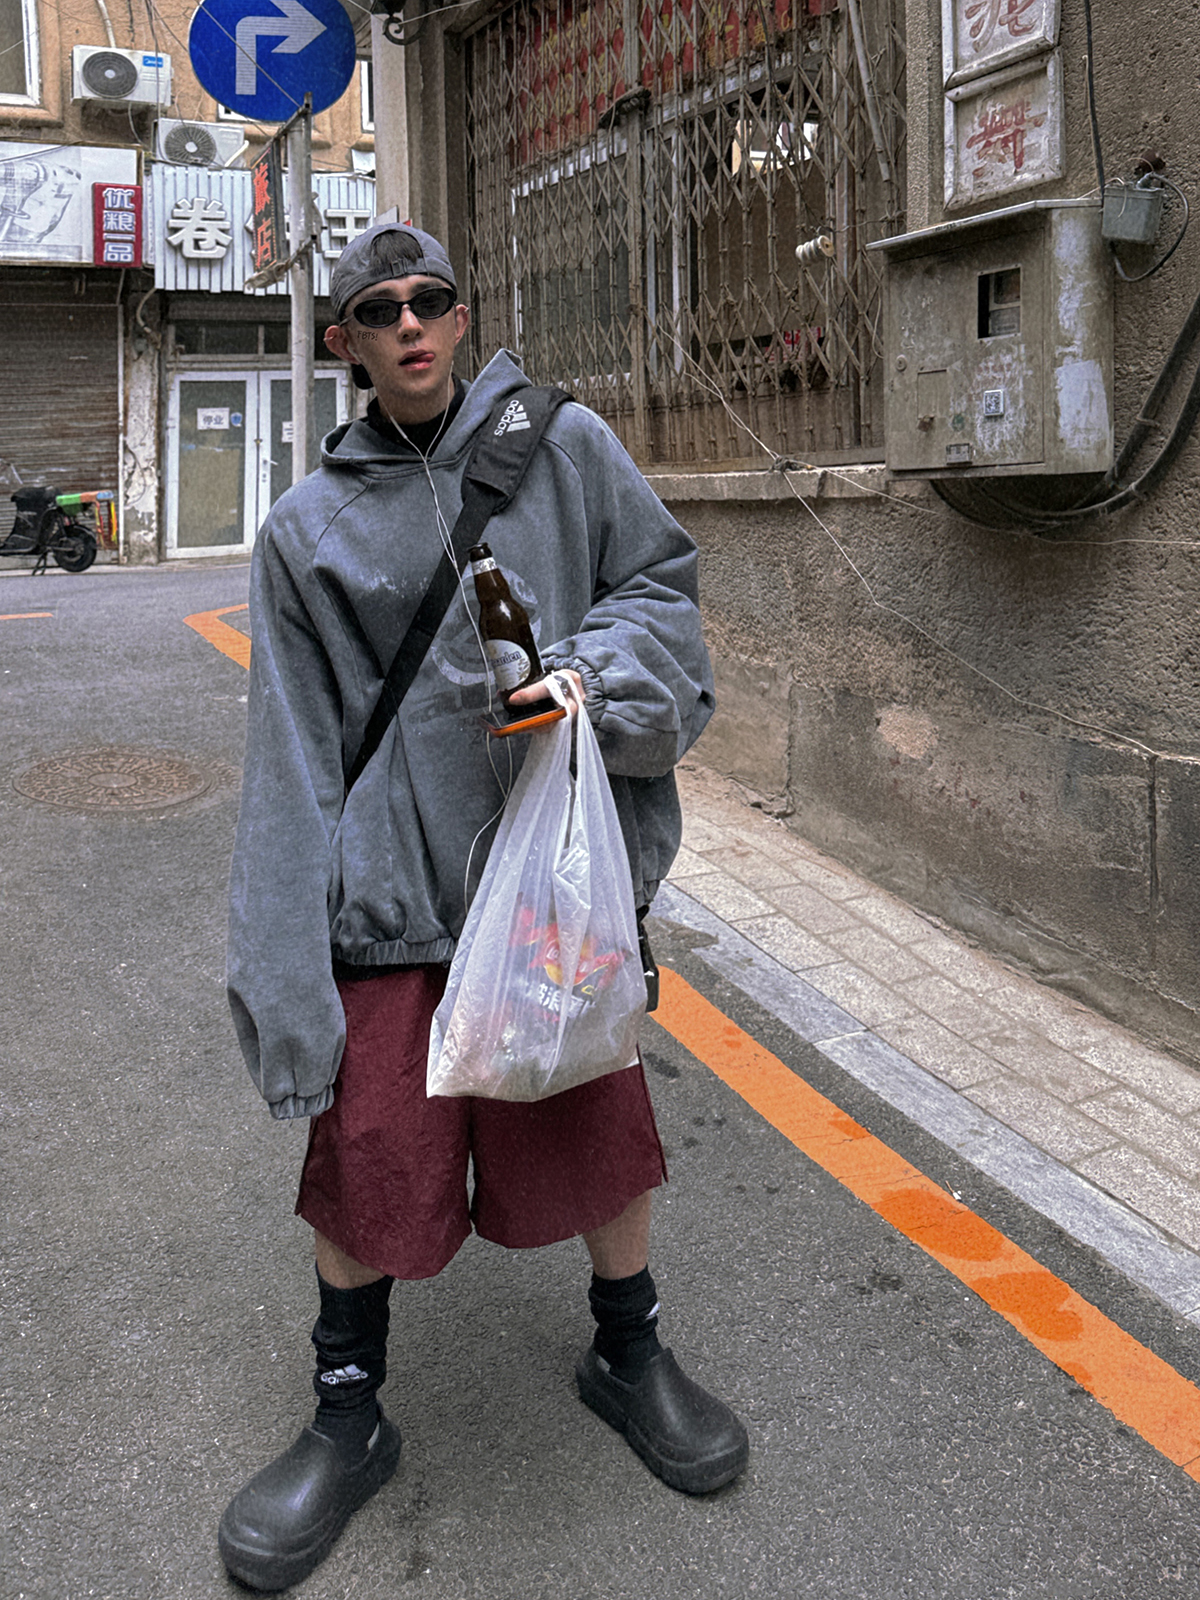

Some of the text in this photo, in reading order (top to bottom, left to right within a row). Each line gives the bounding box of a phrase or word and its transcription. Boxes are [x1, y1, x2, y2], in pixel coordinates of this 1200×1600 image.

[103, 188, 135, 262] 优粮一品
[494, 400, 519, 436] adidas
